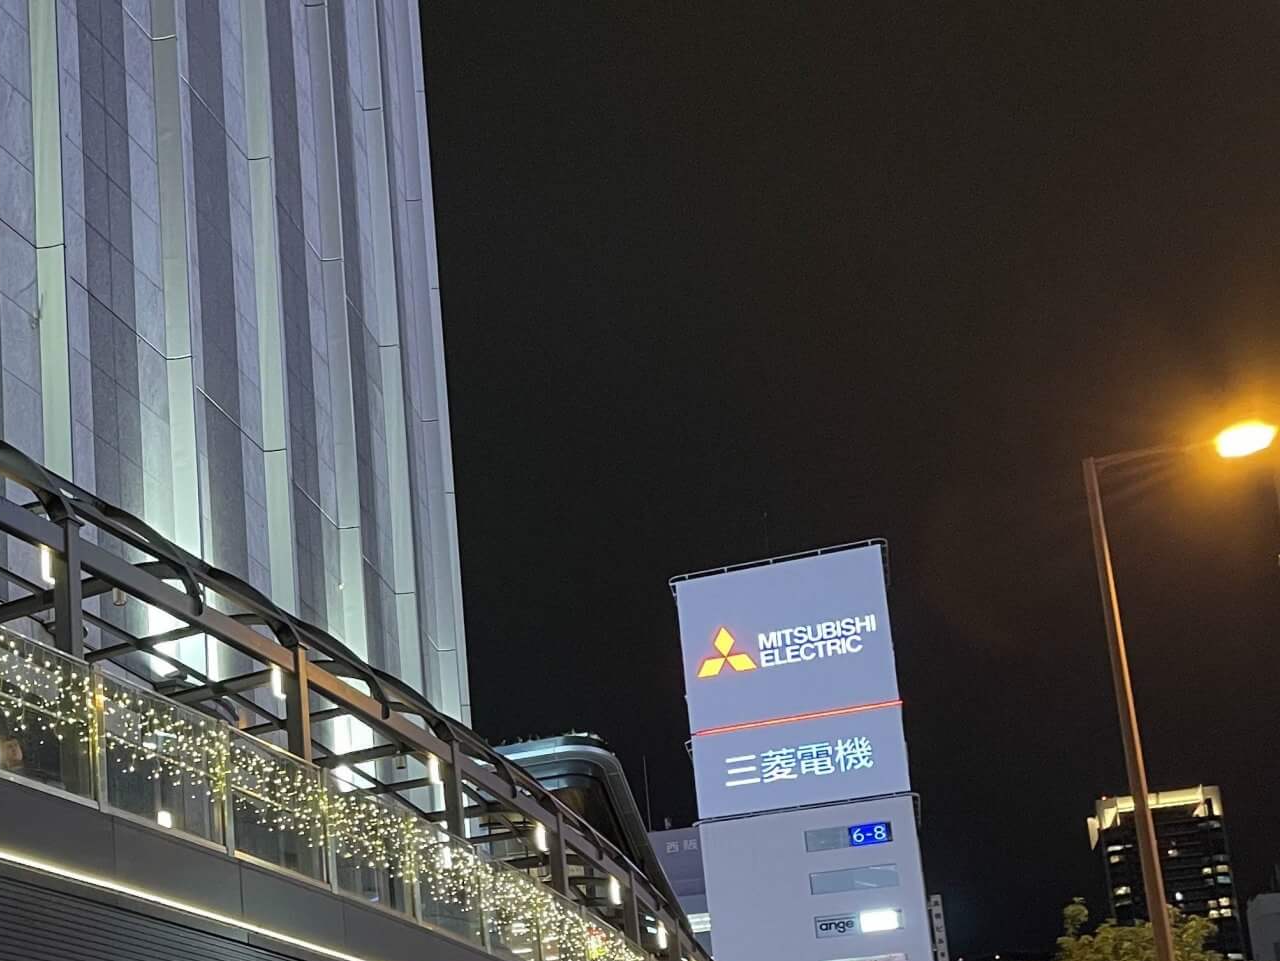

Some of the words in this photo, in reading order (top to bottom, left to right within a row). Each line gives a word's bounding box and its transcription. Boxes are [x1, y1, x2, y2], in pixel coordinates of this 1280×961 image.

[758, 614, 877, 650] MITSUBISHI
[760, 635, 863, 668] ELECTRIC
[725, 736, 874, 787] 三菱電機
[852, 825, 886, 843] 6-8
[819, 918, 855, 933] ange
